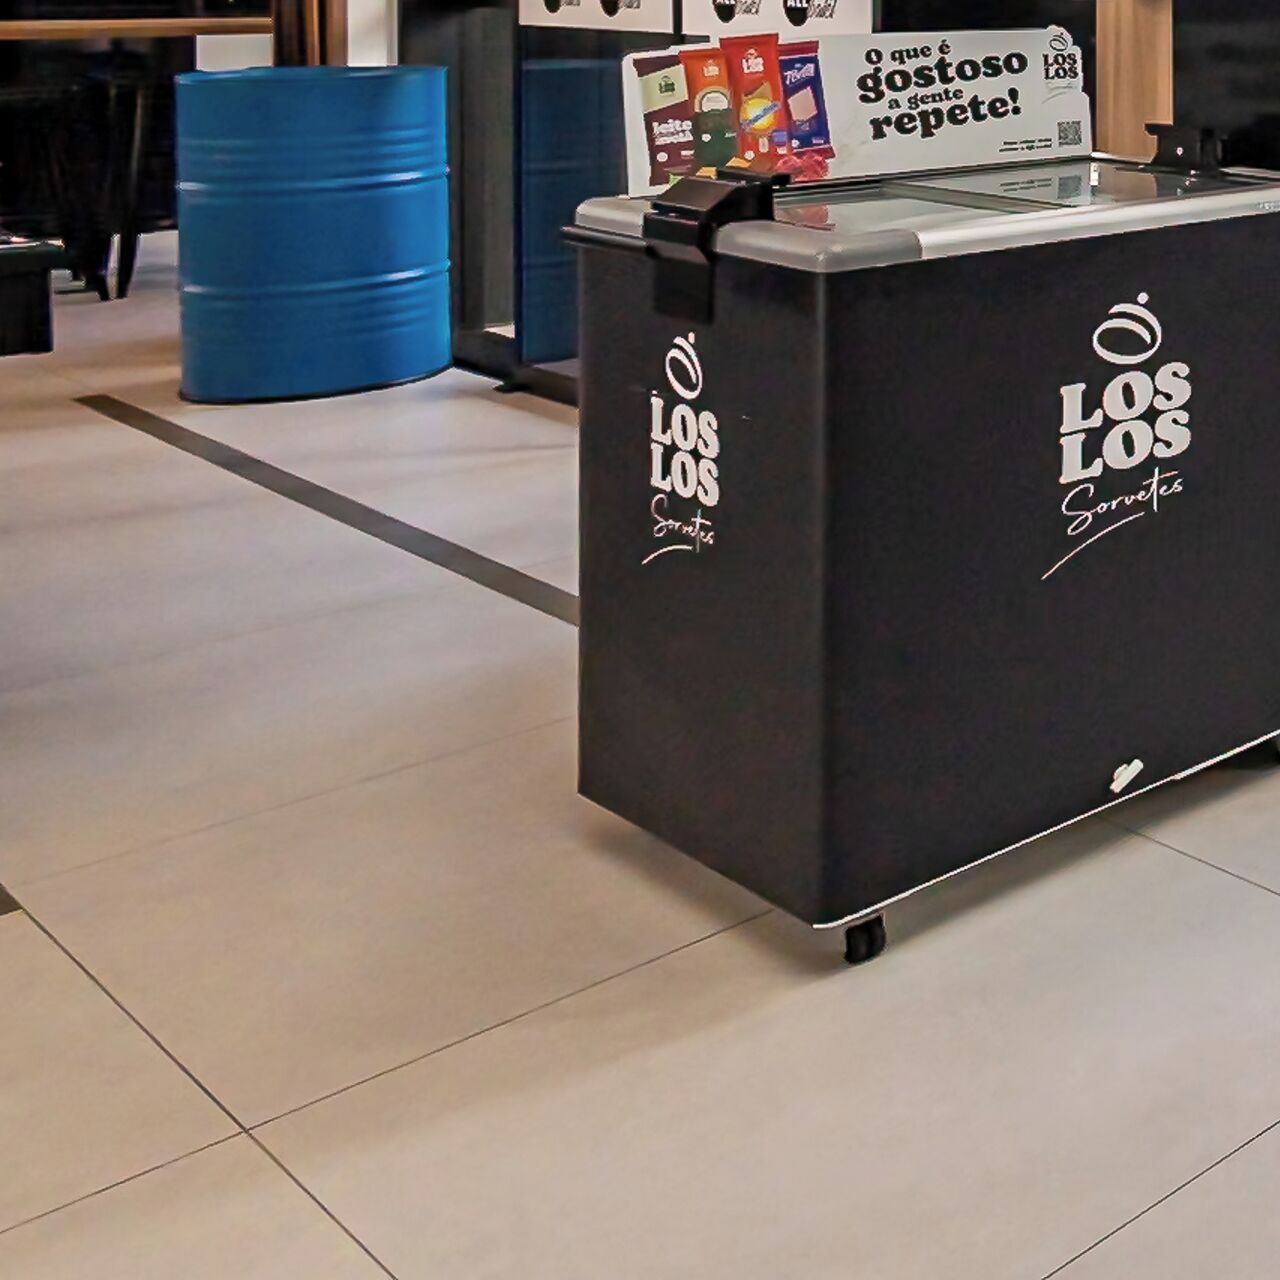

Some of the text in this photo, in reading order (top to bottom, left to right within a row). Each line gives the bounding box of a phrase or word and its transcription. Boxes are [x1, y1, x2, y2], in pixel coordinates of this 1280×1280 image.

[856, 52, 1028, 103] gostoso
[890, 44, 933, 65] que
[938, 39, 951, 56] é
[1042, 53, 1077, 66] LOS
[1044, 66, 1079, 80] LOS
[869, 87, 1022, 140] repete!
[888, 87, 964, 110] a gente
[1059, 361, 1193, 434] LOS
[651, 394, 720, 459] LOS
[1059, 409, 1193, 484] LOS
[651, 443, 720, 507] LOS
[1061, 467, 1184, 536] Sorvetes
